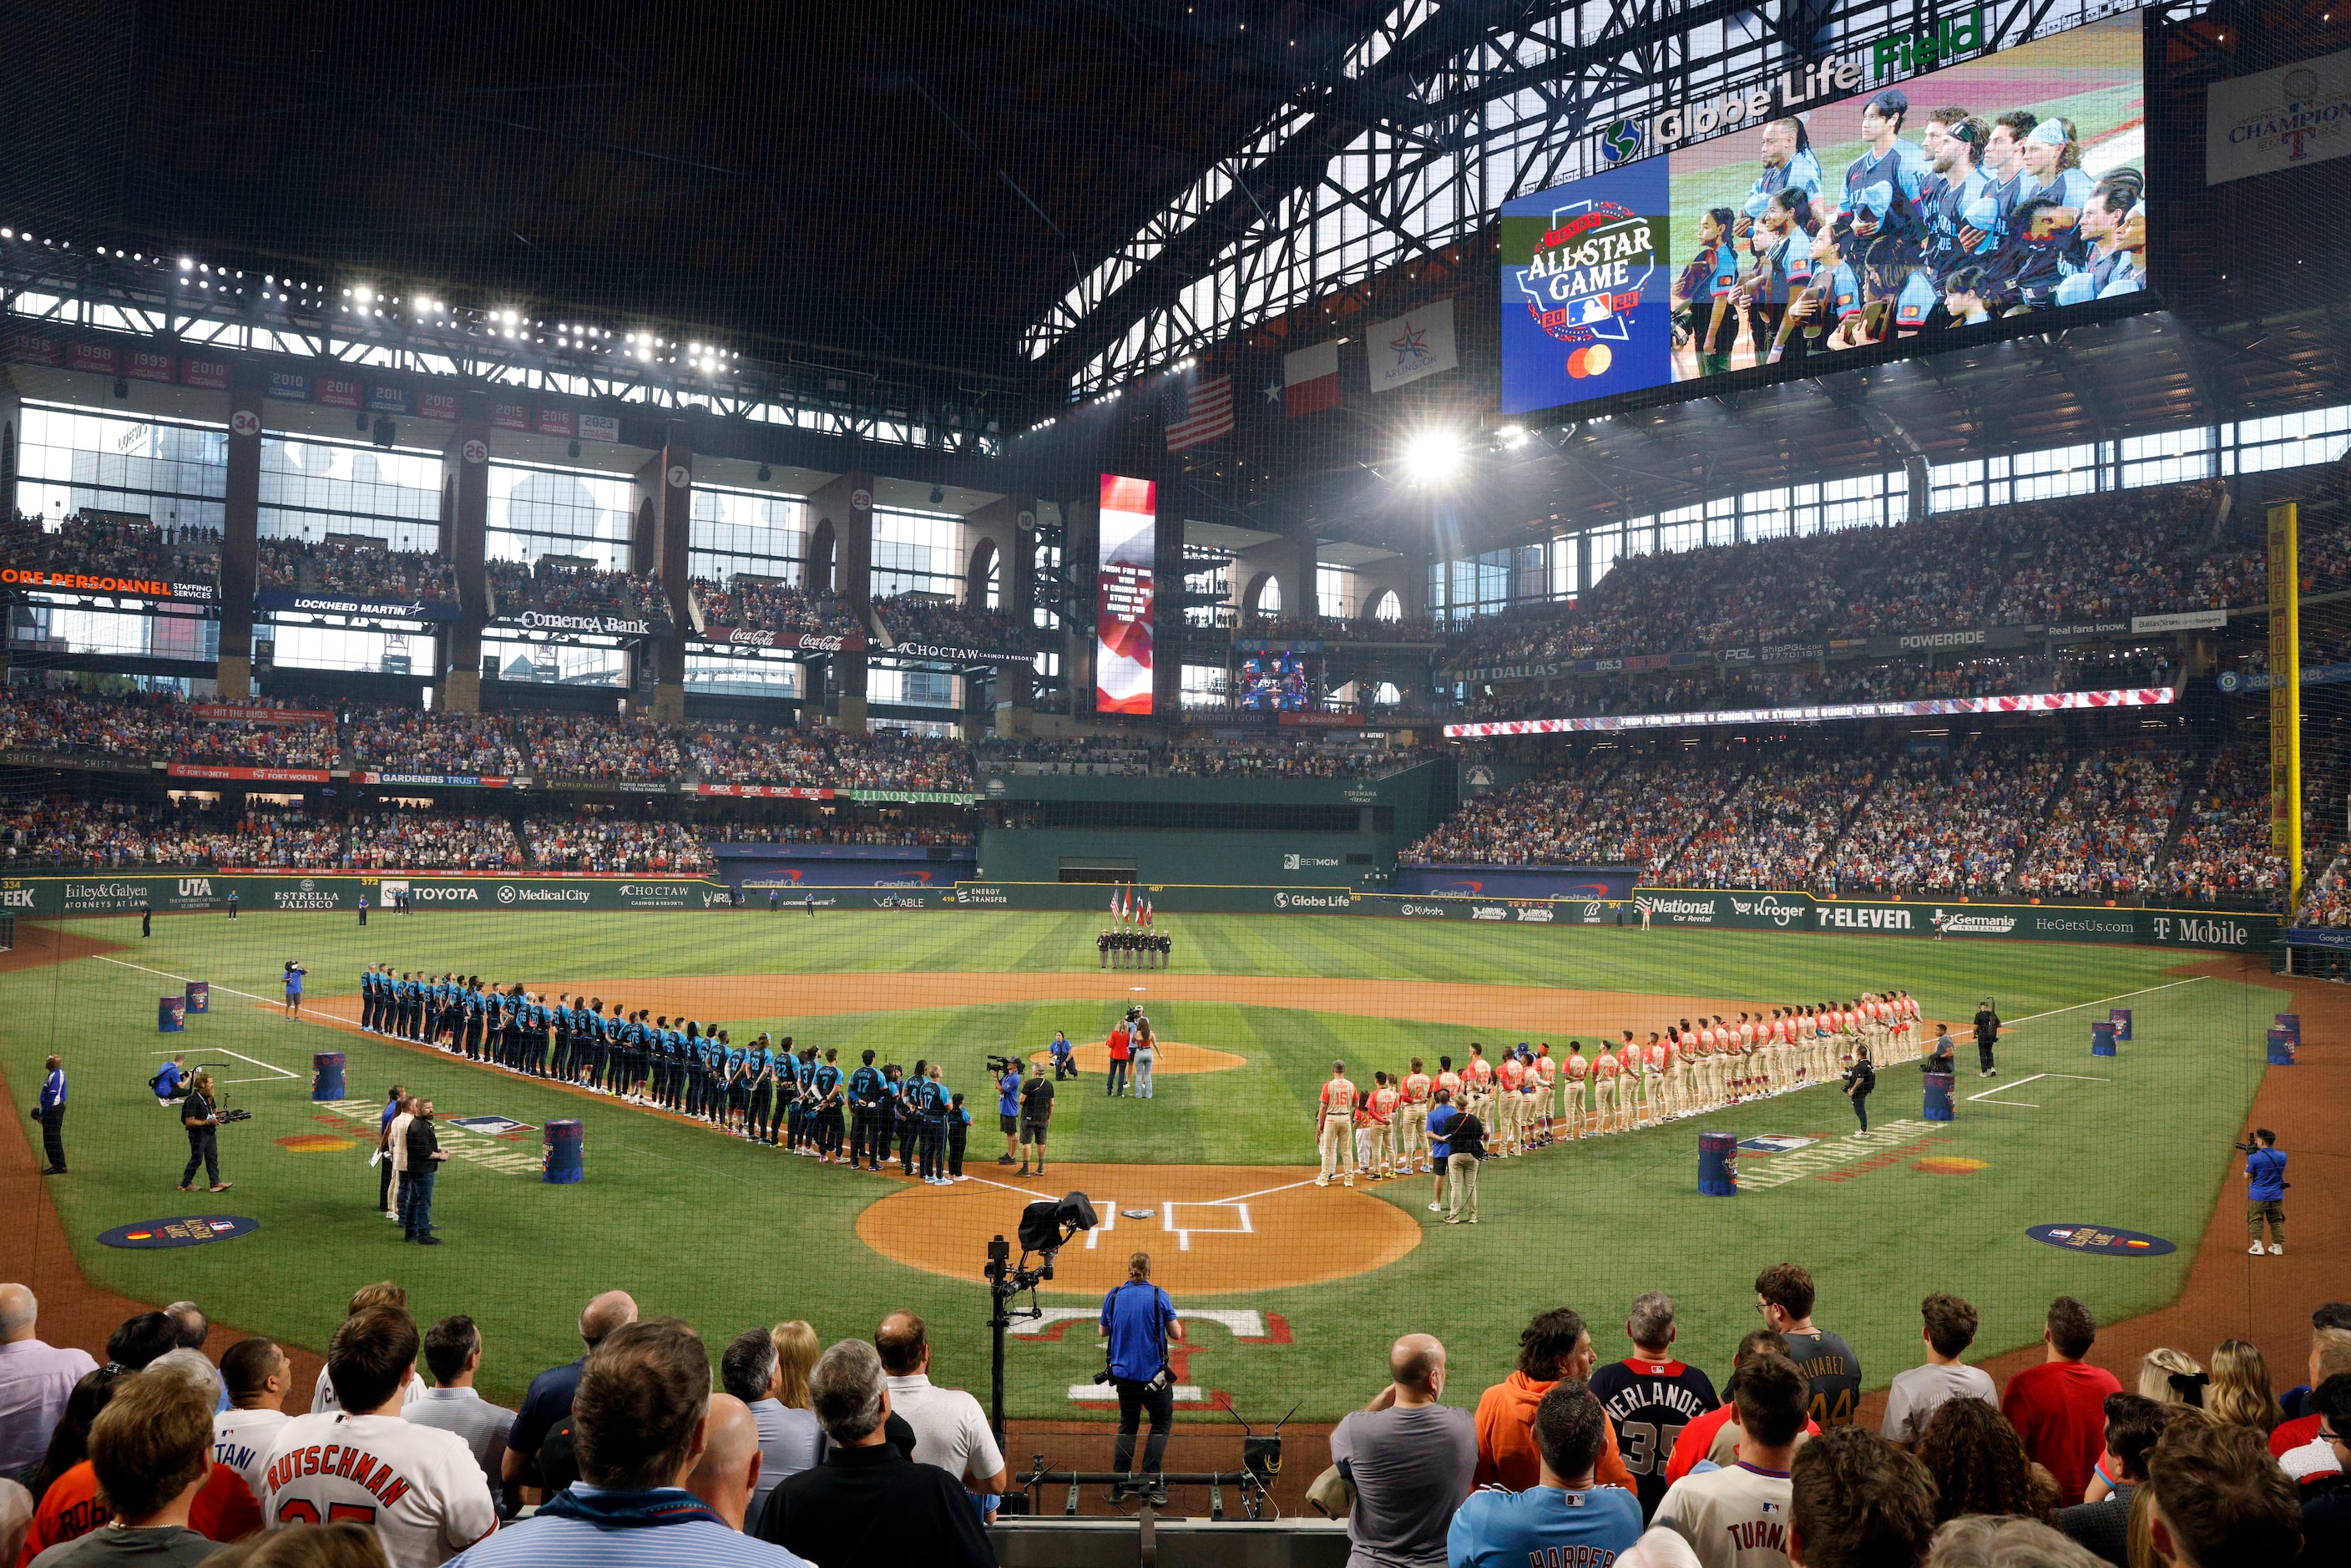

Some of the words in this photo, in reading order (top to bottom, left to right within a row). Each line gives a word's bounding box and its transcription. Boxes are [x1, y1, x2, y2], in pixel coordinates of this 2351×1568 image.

[1653, 90, 1772, 145] Globe
[1782, 54, 1862, 108] Life
[1873, 8, 1982, 80] Field
[1550, 213, 1598, 244] TEXAS
[1549, 259, 1631, 301] GAME
[1615, 294, 1636, 308] 24
[1545, 311, 1564, 325] 20
[77, 345, 112, 361] 1998
[134, 353, 168, 368] 1999
[191, 362, 224, 376] 2010
[1383, 357, 1438, 381] ARLINGTON
[272, 373, 304, 387] 2010
[327, 381, 354, 394] 2011
[377, 387, 402, 402] 2011
[425, 394, 455, 407] 2012
[496, 404, 523, 417] 2015
[543, 411, 569, 423] 2016
[234, 415, 257, 431] 34
[584, 416, 614, 429] 2023
[465, 444, 485, 459] 26
[674, 470, 684, 483] 7
[852, 493, 869, 507] 29
[1021, 514, 1032, 527] 10
[1102, 564, 1121, 574] FROM
[1123, 567, 1136, 575] FAR
[1137, 569, 1152, 577] AND
[0, 569, 44, 585] ORE
[51, 573, 172, 596] PERSONNEL
[1118, 576, 1135, 584] WIDE
[173, 583, 213, 594] STAFFING
[173, 589, 212, 599] SERVICES
[1110, 584, 1138, 594] CANADA
[1110, 594, 1132, 603] STAND
[295, 599, 358, 613] LOCKHEED
[360, 604, 407, 617] MARTIN
[1107, 603, 1130, 612] GUARD
[1132, 605, 1145, 614] FOR
[1117, 614, 1135, 622] THEE
[606, 616, 650, 635] Bank
[2049, 626, 2070, 635] Real
[2073, 625, 2094, 634] fans
[2096, 623, 2127, 633] know.
[1899, 630, 1985, 649] POWERADE
[906, 642, 978, 660] CHOCTAW
[1725, 648, 1755, 660] PGL
[1466, 669, 1488, 681] UT
[1492, 663, 1559, 680] DALLAS
[1595, 660, 1623, 671] 105.3
[230, 709, 244, 718] THE
[245, 711, 268, 719] BUDS
[1238, 714, 1264, 723] GOLD
[1620, 716, 1643, 726] FROM
[1645, 716, 1661, 725] FAR
[1663, 716, 1681, 725] AND
[1684, 714, 1706, 723] WIDE
[1716, 712, 1752, 721] CANADA
[1755, 711, 1769, 721] WE
[1772, 710, 1802, 720] STAND
[1805, 709, 1818, 717] ON
[1821, 706, 1853, 716] GUARD
[1856, 706, 1875, 716] FOR
[1878, 704, 1904, 714] THEE
[6, 753, 36, 763] SHIFT
[84, 759, 111, 769] SHIFT
[289, 773, 318, 781] WORTH
[382, 773, 444, 784] GARDENERS
[447, 776, 478, 785] TRUST
[863, 791, 910, 802] LUXOR
[911, 792, 974, 804] STAFFING
[1300, 857, 1338, 867] BETMGM
[3, 881, 21, 889] 334
[178, 878, 213, 897] UTA
[625, 884, 690, 896] CHOCTAW
[0, 888, 35, 908] EEK
[274, 892, 340, 901] ESTRELLA
[412, 888, 479, 901] TOYOTA
[518, 889, 565, 901] Medical
[565, 889, 590, 904] City
[971, 888, 1000, 896] ENERGY
[280, 900, 334, 909] JALISCO
[972, 896, 1008, 904] TRANSFER
[1292, 895, 1327, 907] Globe
[1328, 895, 1350, 907] Life
[1652, 898, 1714, 915] National
[1414, 906, 1444, 916] Kubota
[1480, 907, 1503, 916] ARROW
[1526, 908, 1550, 917] ARROW
[1754, 896, 1805, 926] Kroger
[1954, 913, 2015, 927] Germania
[2035, 918, 2135, 933] HeGetsUs.com
[2178, 918, 2248, 945] Mobile
[2318, 933, 2344, 943] Google
[776, 1065, 787, 1077] 22
[1604, 1066, 1615, 1079] 39
[822, 1076, 829, 1090] 7
[857, 1080, 871, 1094] 17
[1335, 1090, 1348, 1105] 15
[1379, 1101, 1393, 1115] 38
[1605, 1383, 1708, 1422] VERLANDE
[1807, 1388, 1853, 1429] 44
[214, 1444, 256, 1471] TANI
[266, 1444, 410, 1510] RUTSCHMAN
[59, 1500, 115, 1535] ROB
[1727, 1523, 1788, 1554] TURN
